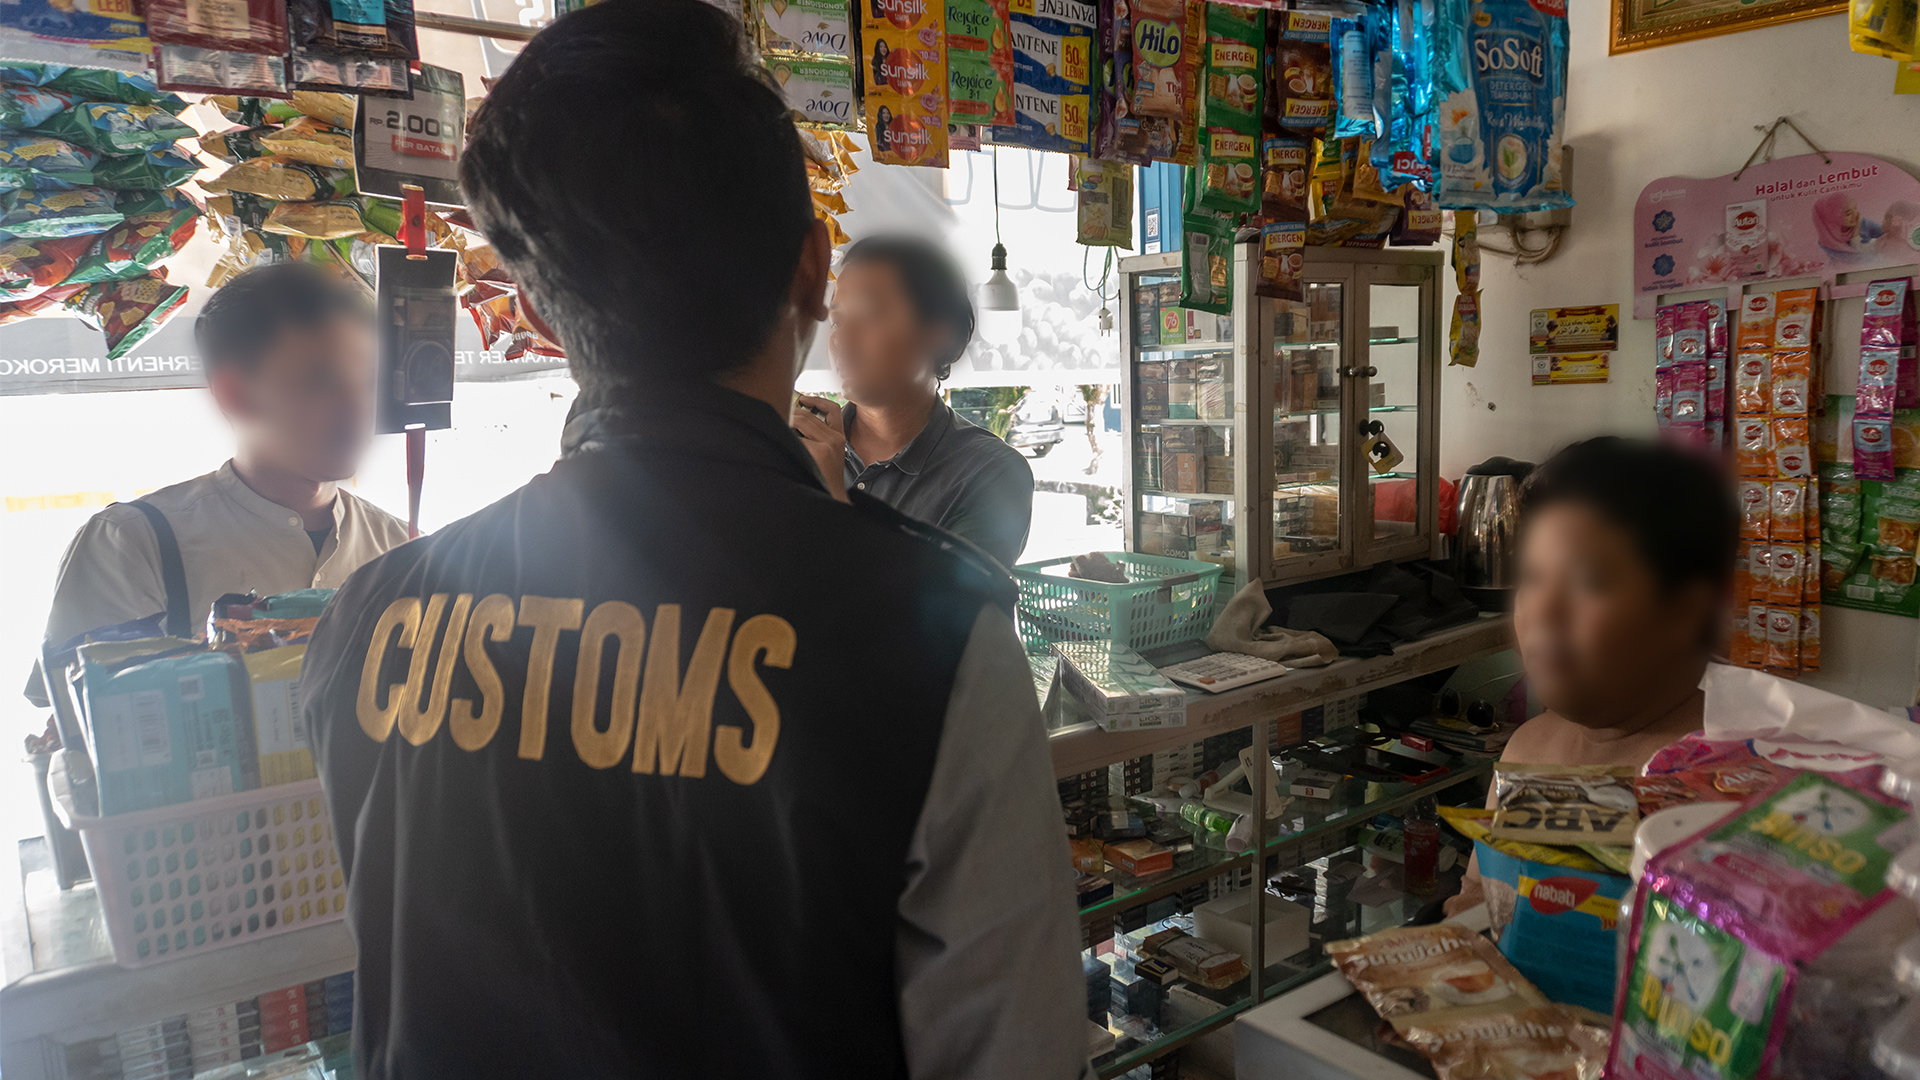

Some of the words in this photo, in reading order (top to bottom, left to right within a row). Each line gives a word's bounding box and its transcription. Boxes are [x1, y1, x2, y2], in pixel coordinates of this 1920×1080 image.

[948, 6, 990, 26] Rejoice
[1039, 0, 1096, 24] PANTENE
[802, 30, 846, 53] Dove
[1010, 32, 1058, 56] ANTENE
[1214, 49, 1255, 64] ENERGEN
[1474, 37, 1543, 79] SoSoft
[800, 67, 849, 77] KONDISIONER
[951, 71, 993, 90] Rejoice
[806, 99, 850, 120] Dove
[1289, 104, 1328, 116] ENERGEN
[386, 110, 456, 139] 2.000
[395, 140, 414, 149] PER
[1214, 138, 1251, 152] ENERGEN
[1271, 149, 1305, 160] ENERGEN
[1755, 179, 1793, 196] Halal
[1796, 177, 1816, 189] dan
[1818, 165, 1879, 185] Lembut
[1770, 191, 1796, 203] untuk
[1797, 187, 1818, 198] Kulit
[1819, 181, 1863, 194] Cantikmu
[1411, 213, 1442, 223] ENERGEN
[1732, 214, 1760, 228] Autan
[1268, 233, 1304, 246] ENERGEN
[1166, 313, 1178, 330] 76
[356, 593, 797, 786] CUSTOMS
[1502, 806, 1626, 832] ABC
[1534, 883, 1576, 909] nabati
